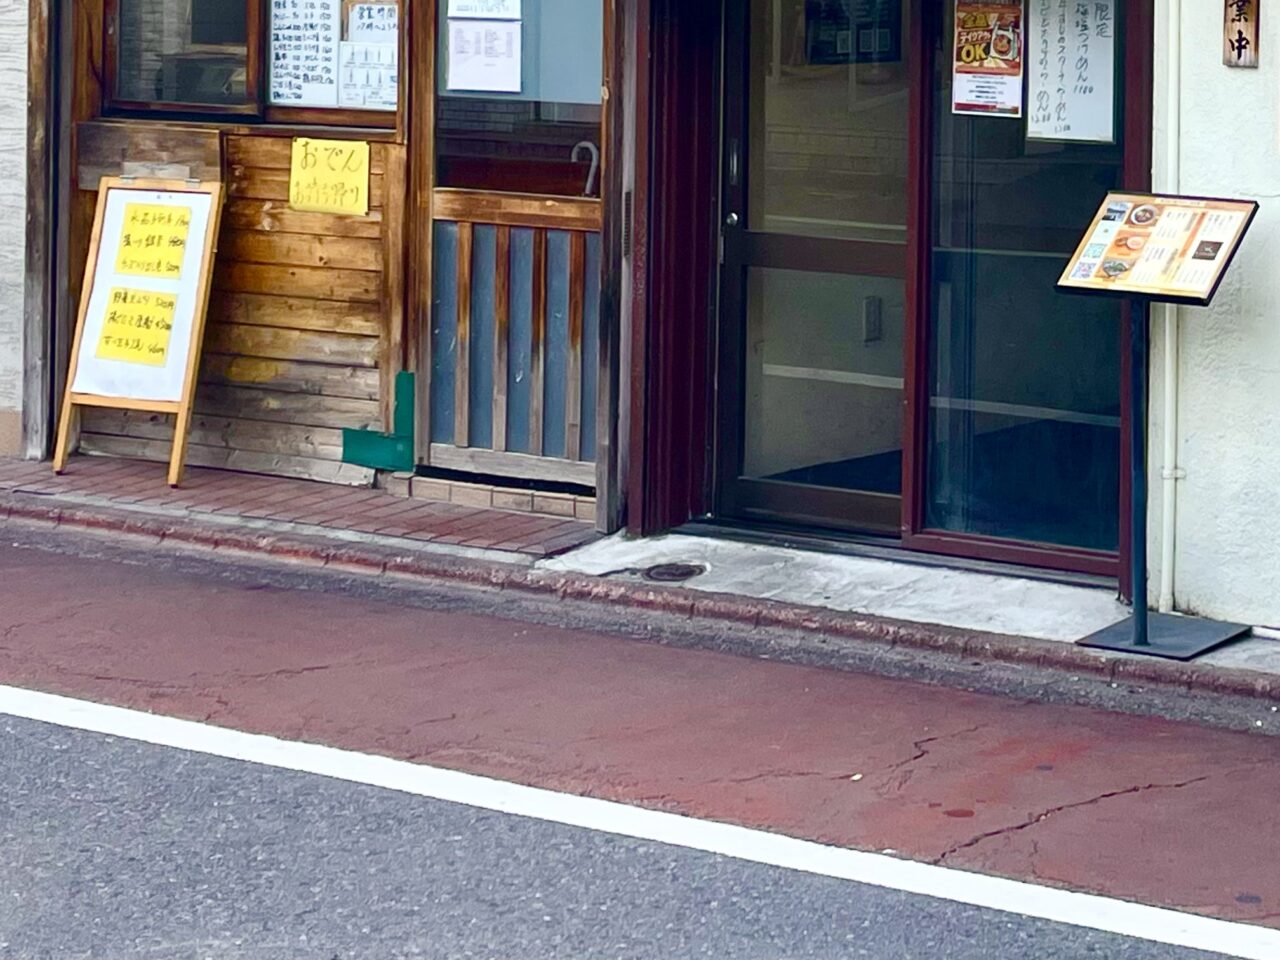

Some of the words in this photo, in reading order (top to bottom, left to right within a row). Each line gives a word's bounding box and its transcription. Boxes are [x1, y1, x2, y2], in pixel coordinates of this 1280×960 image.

[1094, 2, 1113, 38] 限定
[961, 43, 988, 63] OK
[300, 141, 363, 172] おでん
